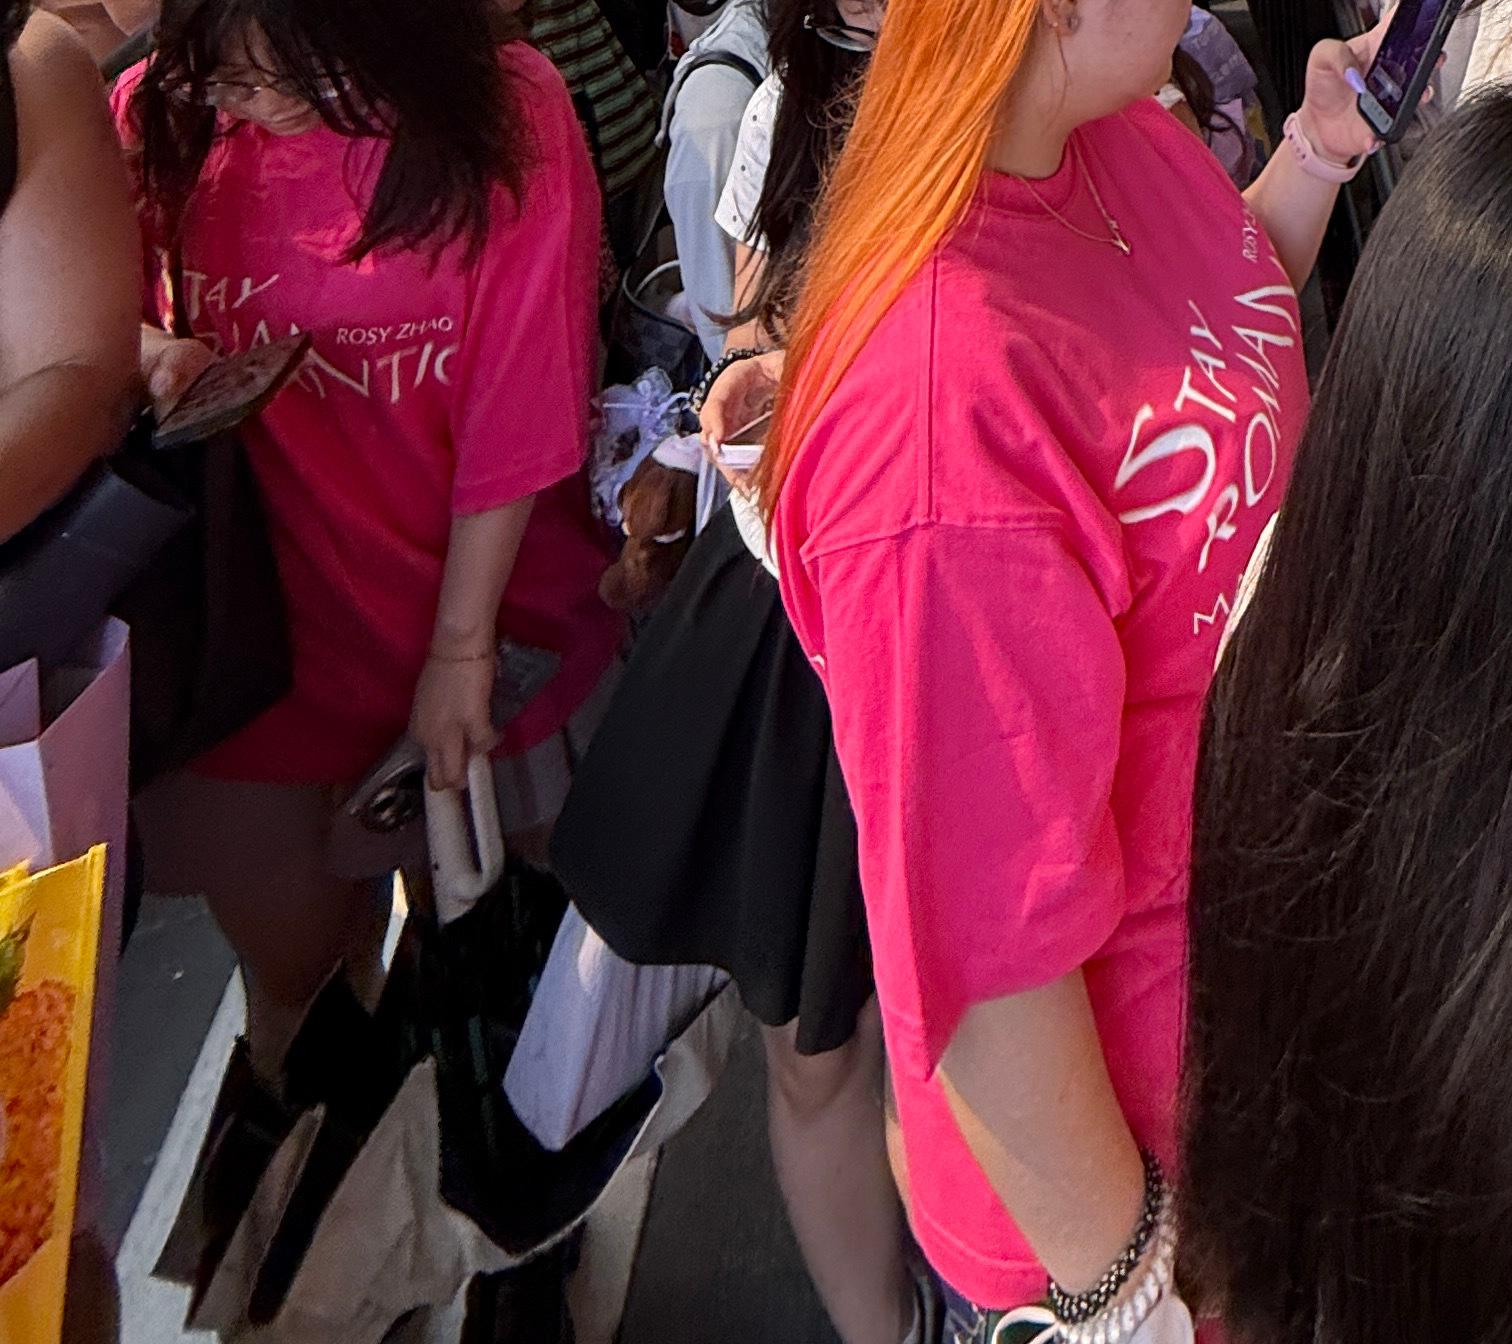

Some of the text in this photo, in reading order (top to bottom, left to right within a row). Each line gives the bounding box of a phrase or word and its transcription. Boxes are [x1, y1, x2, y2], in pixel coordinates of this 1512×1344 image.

[336, 316, 453, 345] ROSY ZHAO
[1115, 299, 1237, 525] STAY
